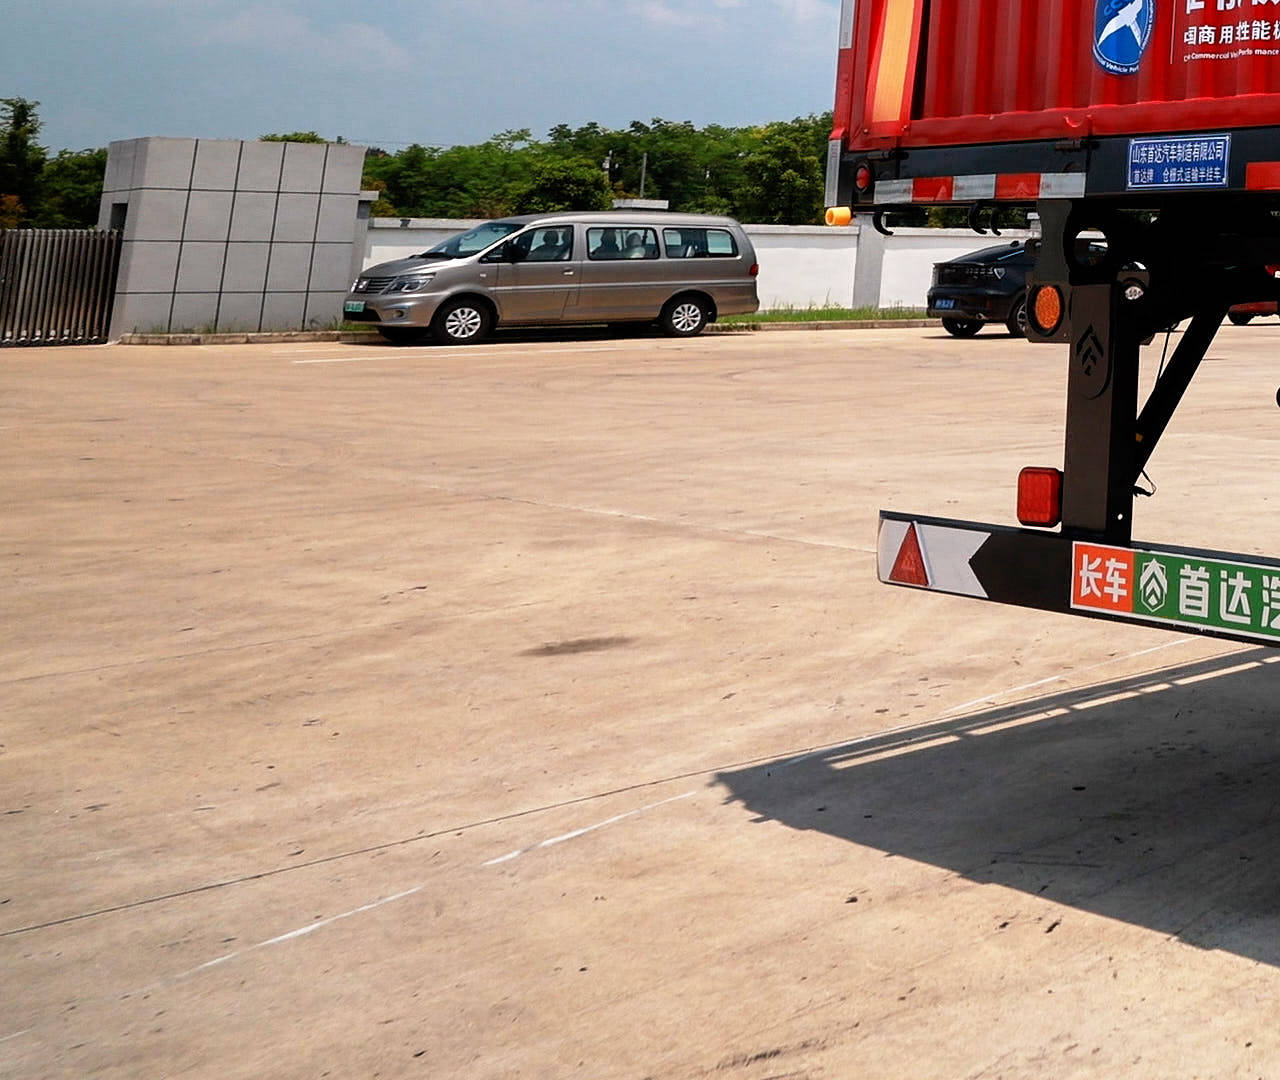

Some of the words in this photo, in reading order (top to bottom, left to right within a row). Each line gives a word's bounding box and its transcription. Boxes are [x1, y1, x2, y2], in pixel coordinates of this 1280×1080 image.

[1132, 141, 1224, 164] 山东首达汽车制造有限公司
[1079, 553, 1128, 604] 长车
